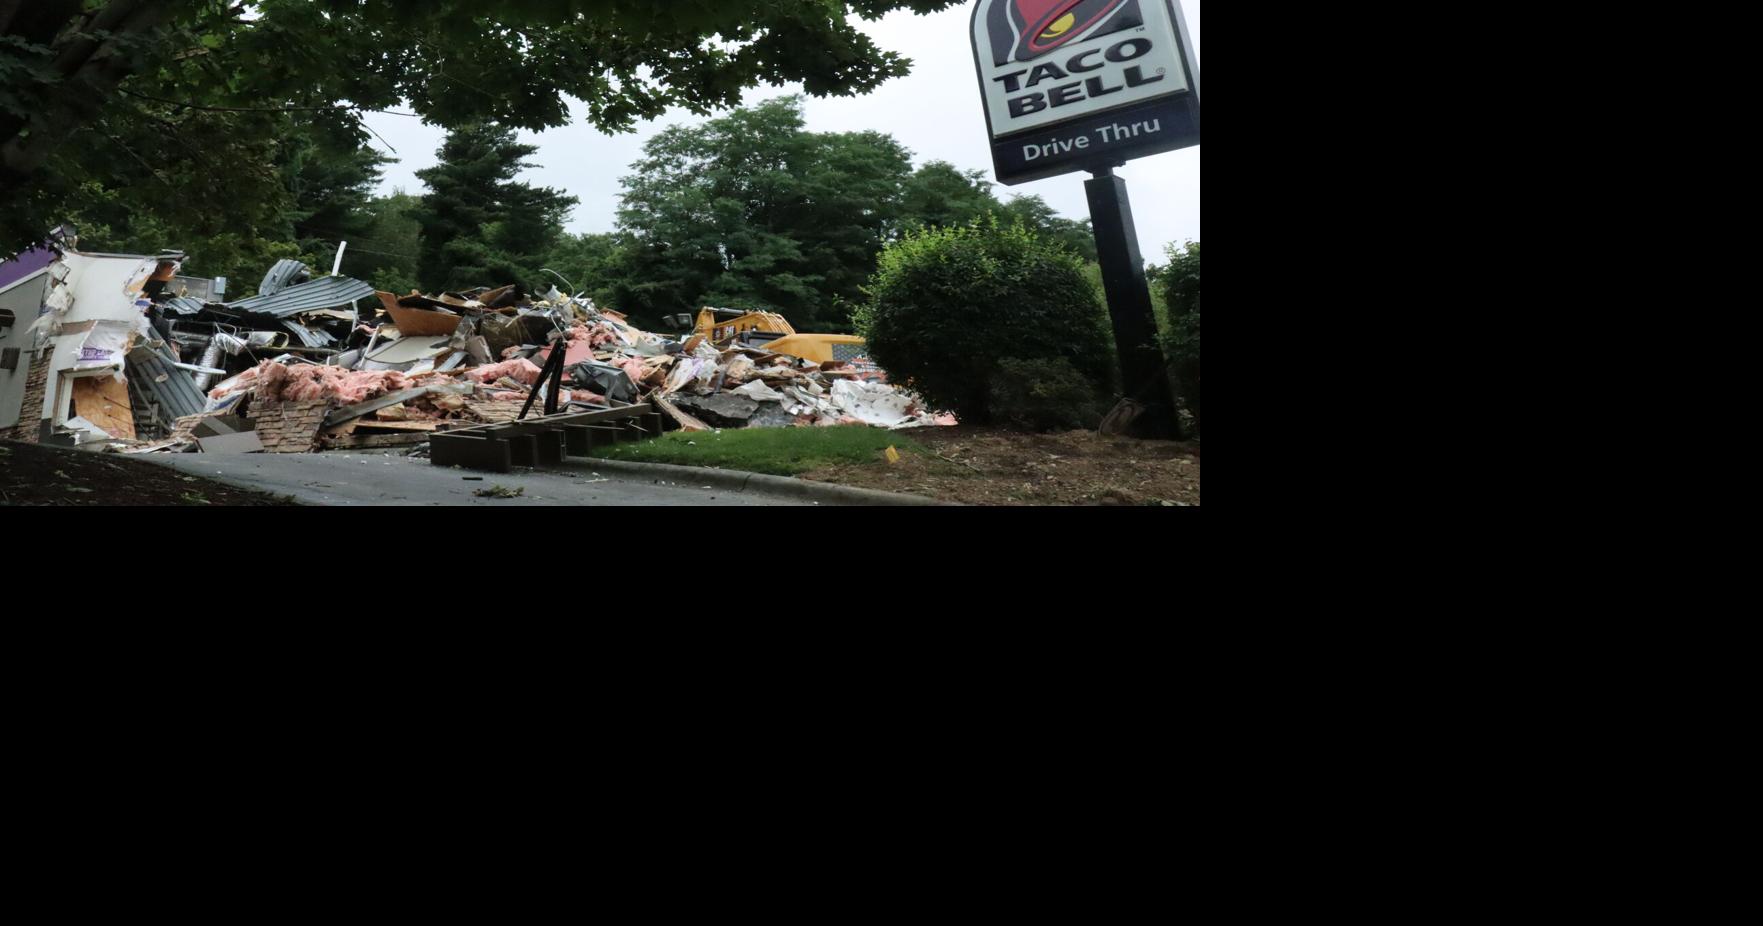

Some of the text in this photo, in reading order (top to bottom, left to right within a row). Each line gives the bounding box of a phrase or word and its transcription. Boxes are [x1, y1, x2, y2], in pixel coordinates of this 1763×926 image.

[992, 37, 1153, 93] TACO
[1007, 64, 1165, 119] BELL
[1022, 118, 1161, 161] Drive Thru
